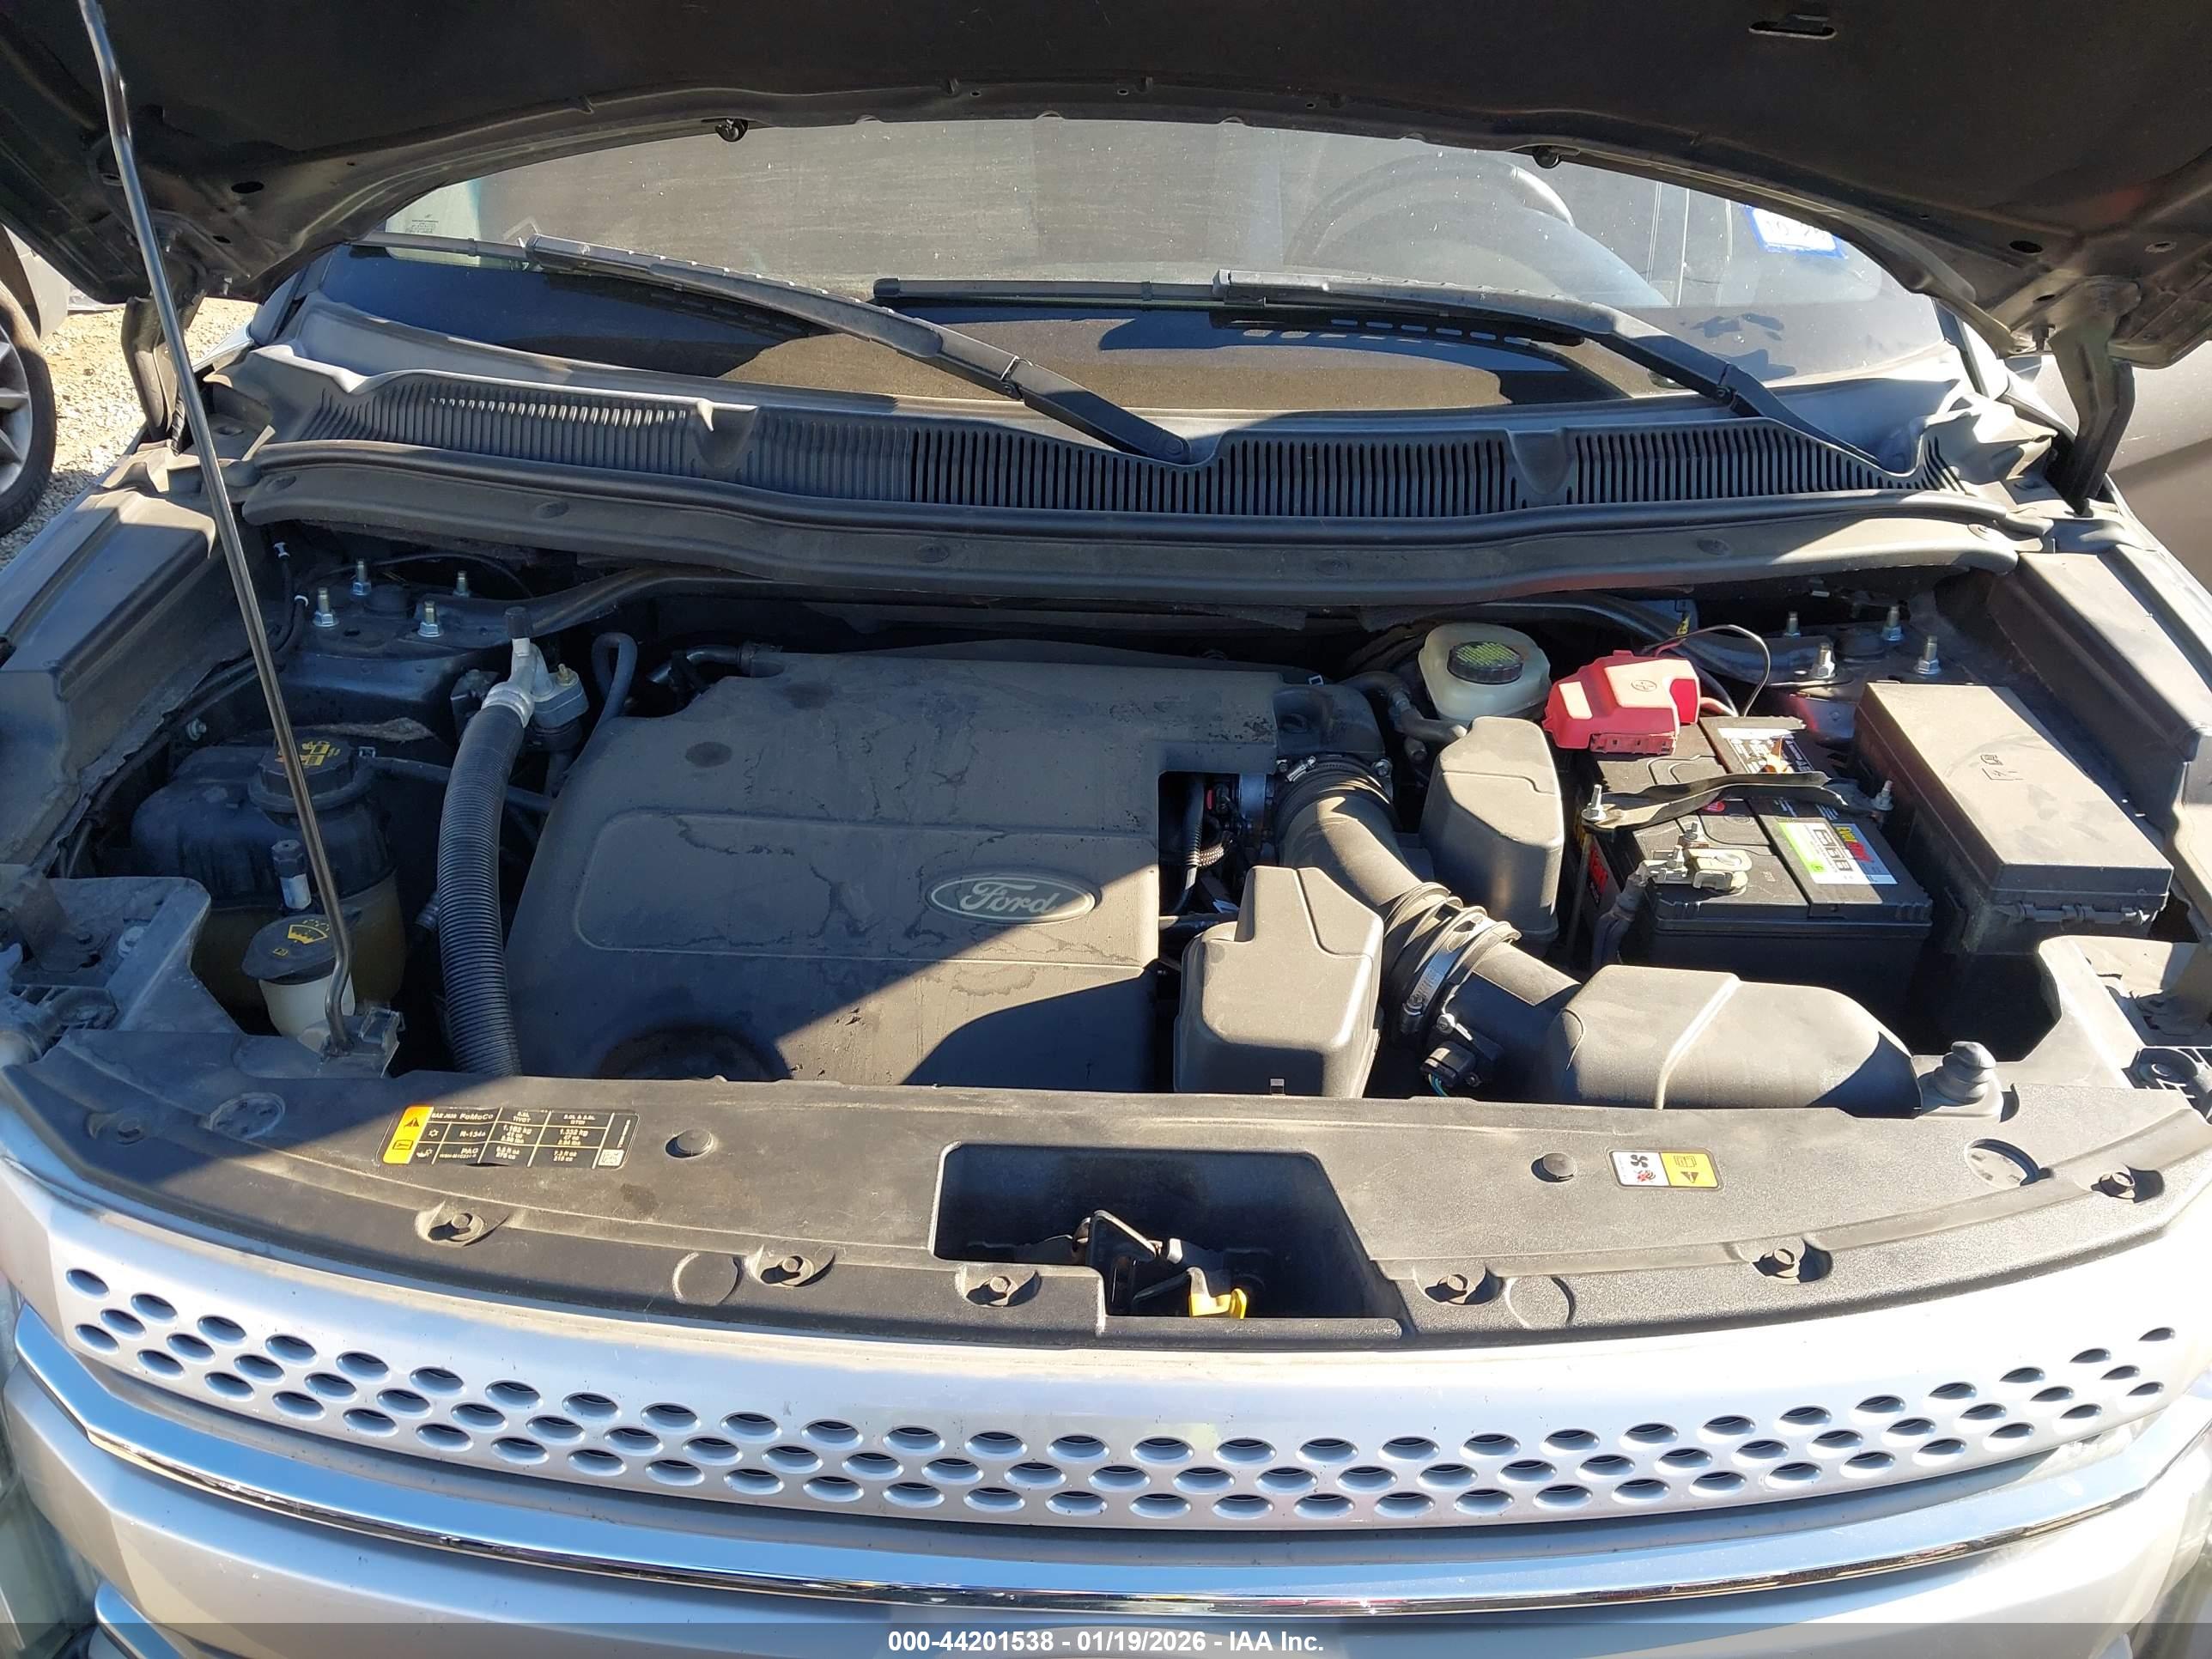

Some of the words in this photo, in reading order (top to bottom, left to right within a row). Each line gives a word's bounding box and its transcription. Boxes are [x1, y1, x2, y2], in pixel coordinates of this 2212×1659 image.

[960, 881, 1060, 913] Ford
[522, 1126, 532, 1135] kg
[579, 1128, 589, 1138] kg
